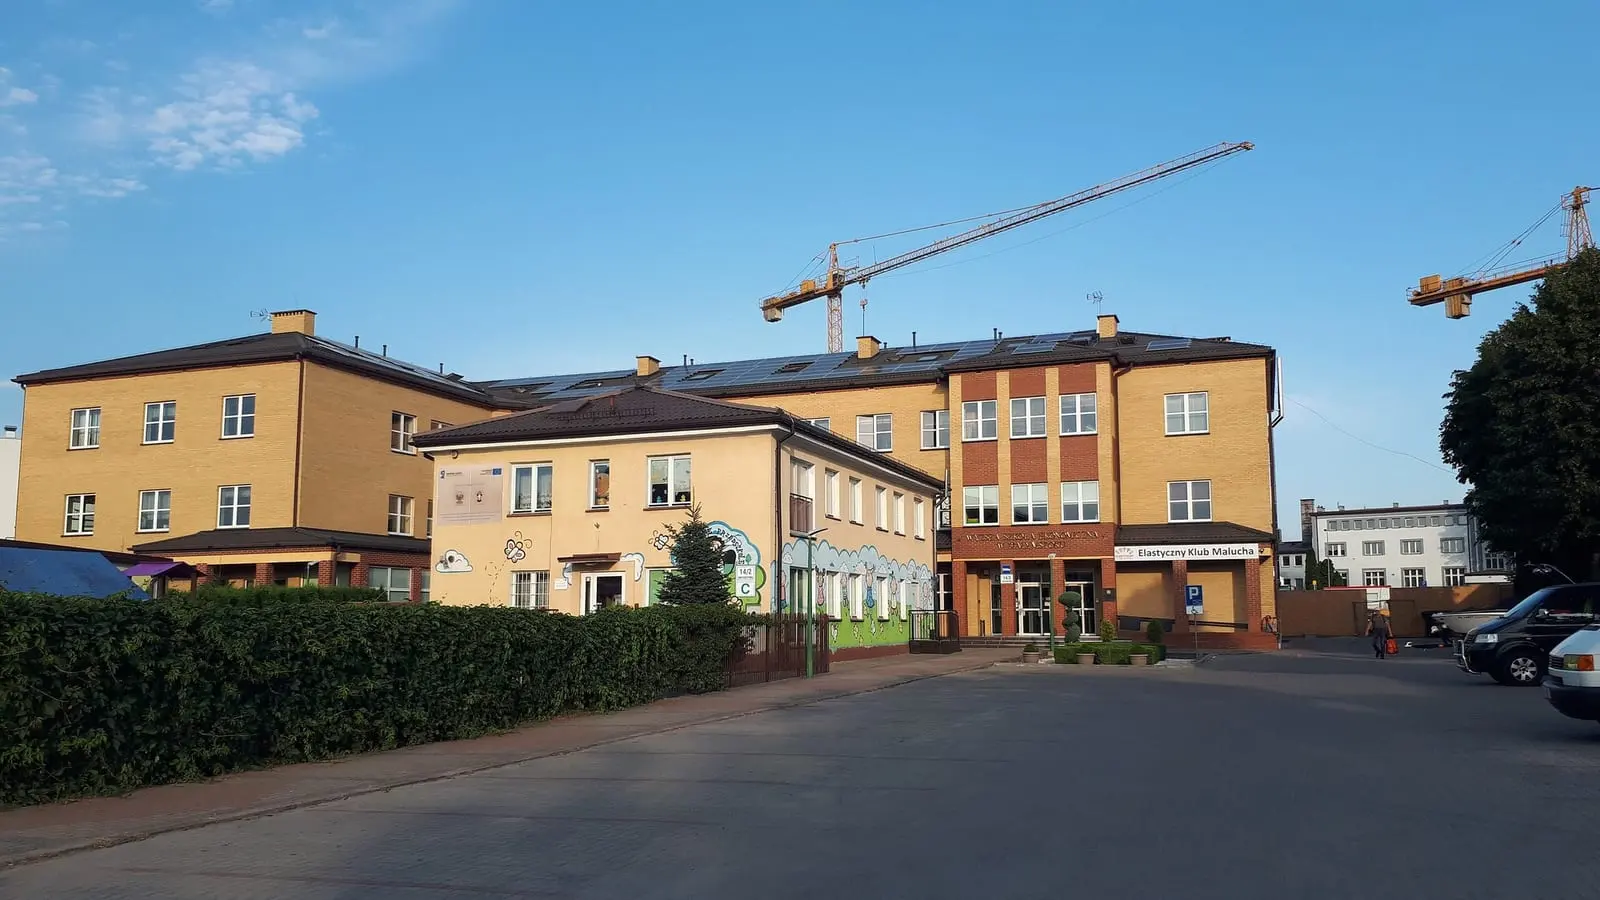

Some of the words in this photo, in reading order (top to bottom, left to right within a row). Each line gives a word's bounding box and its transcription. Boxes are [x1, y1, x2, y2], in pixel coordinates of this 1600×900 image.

[1138, 547, 1186, 558] Elastyczny
[1188, 547, 1209, 556] Klub
[1212, 546, 1254, 556] Malucha
[741, 583, 750, 594] C
[1189, 586, 1199, 600] P
